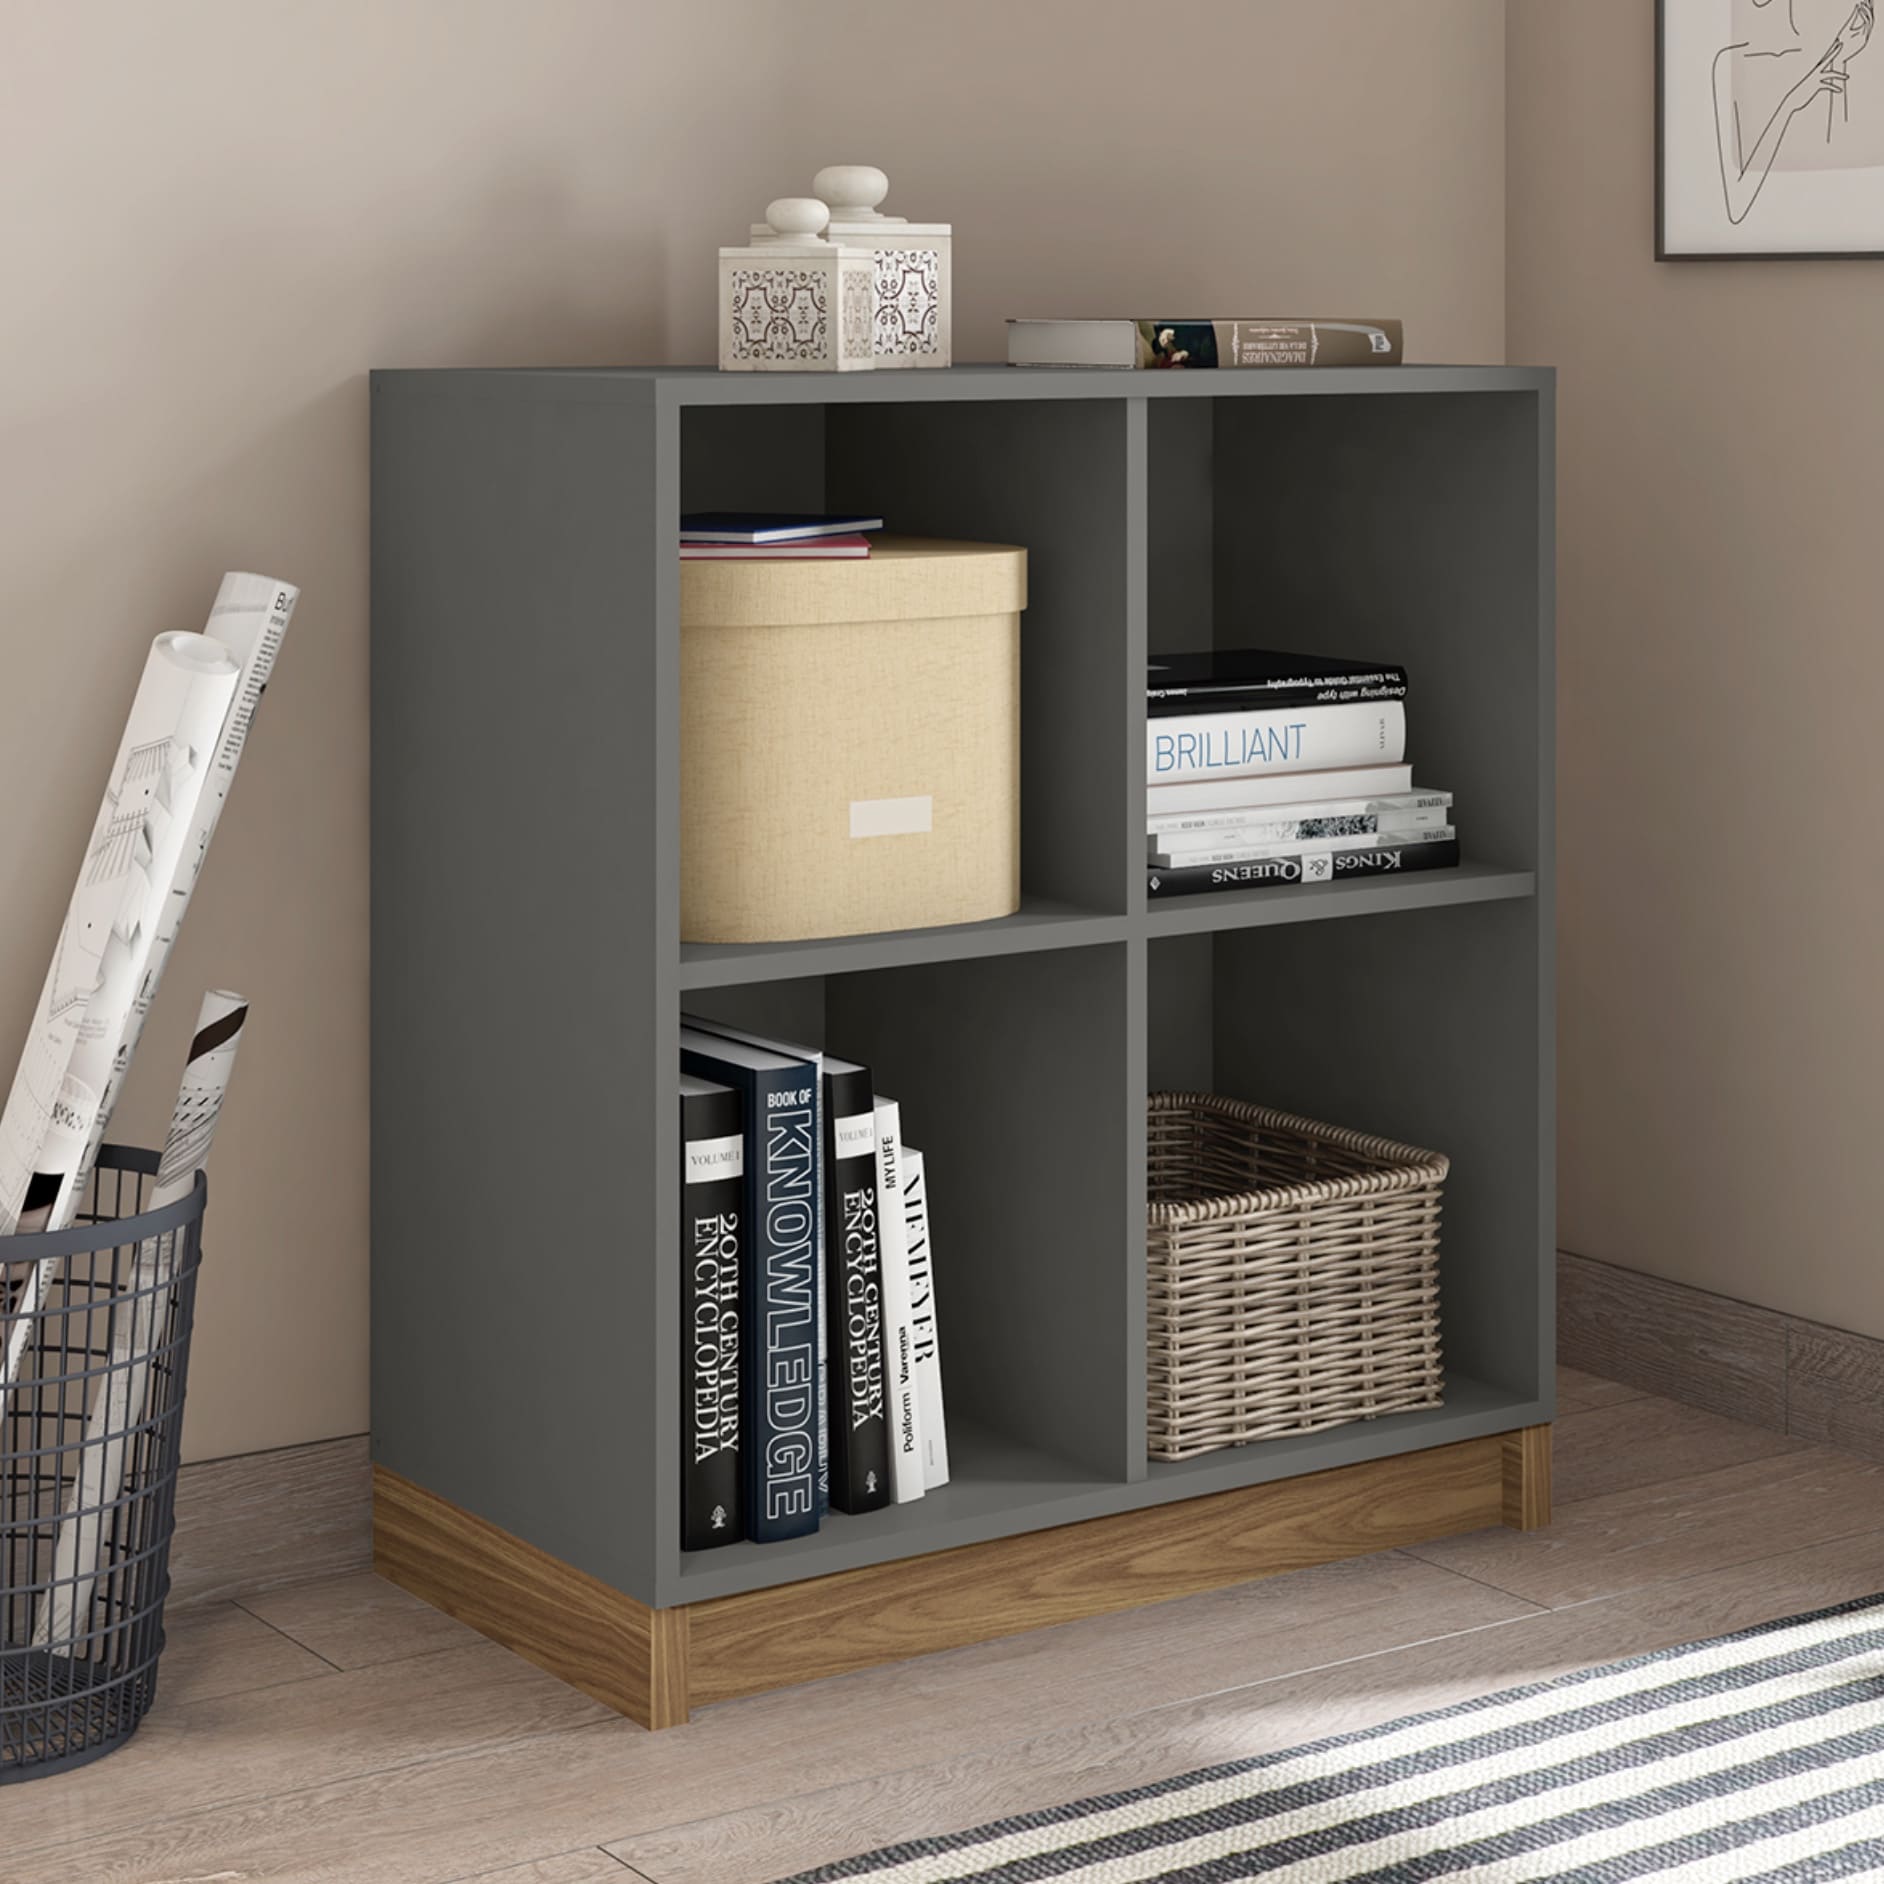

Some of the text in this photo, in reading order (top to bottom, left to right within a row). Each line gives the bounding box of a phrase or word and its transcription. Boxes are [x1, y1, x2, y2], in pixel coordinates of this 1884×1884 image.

[1266, 677, 1313, 690] Typography
[1316, 686, 1406, 700] Designing with type
[1348, 674, 1384, 684] Essential
[1384, 672, 1400, 681] The
[1155, 723, 1307, 772] BRILLIANT
[1211, 850, 1403, 884] KINGS & QUEENS
[767, 1087, 813, 1108] BOOK OF
[690, 1151, 734, 1167] VOLUME
[903, 1173, 935, 1364] NIEMEYER
[766, 1109, 813, 1521] KNOWLEDGE
[842, 1190, 871, 1432] ENCYCLOPEDIA
[859, 1187, 884, 1421] 20TH CENTURY
[694, 1216, 720, 1465] ENCYCLOPEDIA
[718, 1212, 740, 1452] 20TH CENTURY
[898, 1325, 915, 1454] Poliform Varenna
